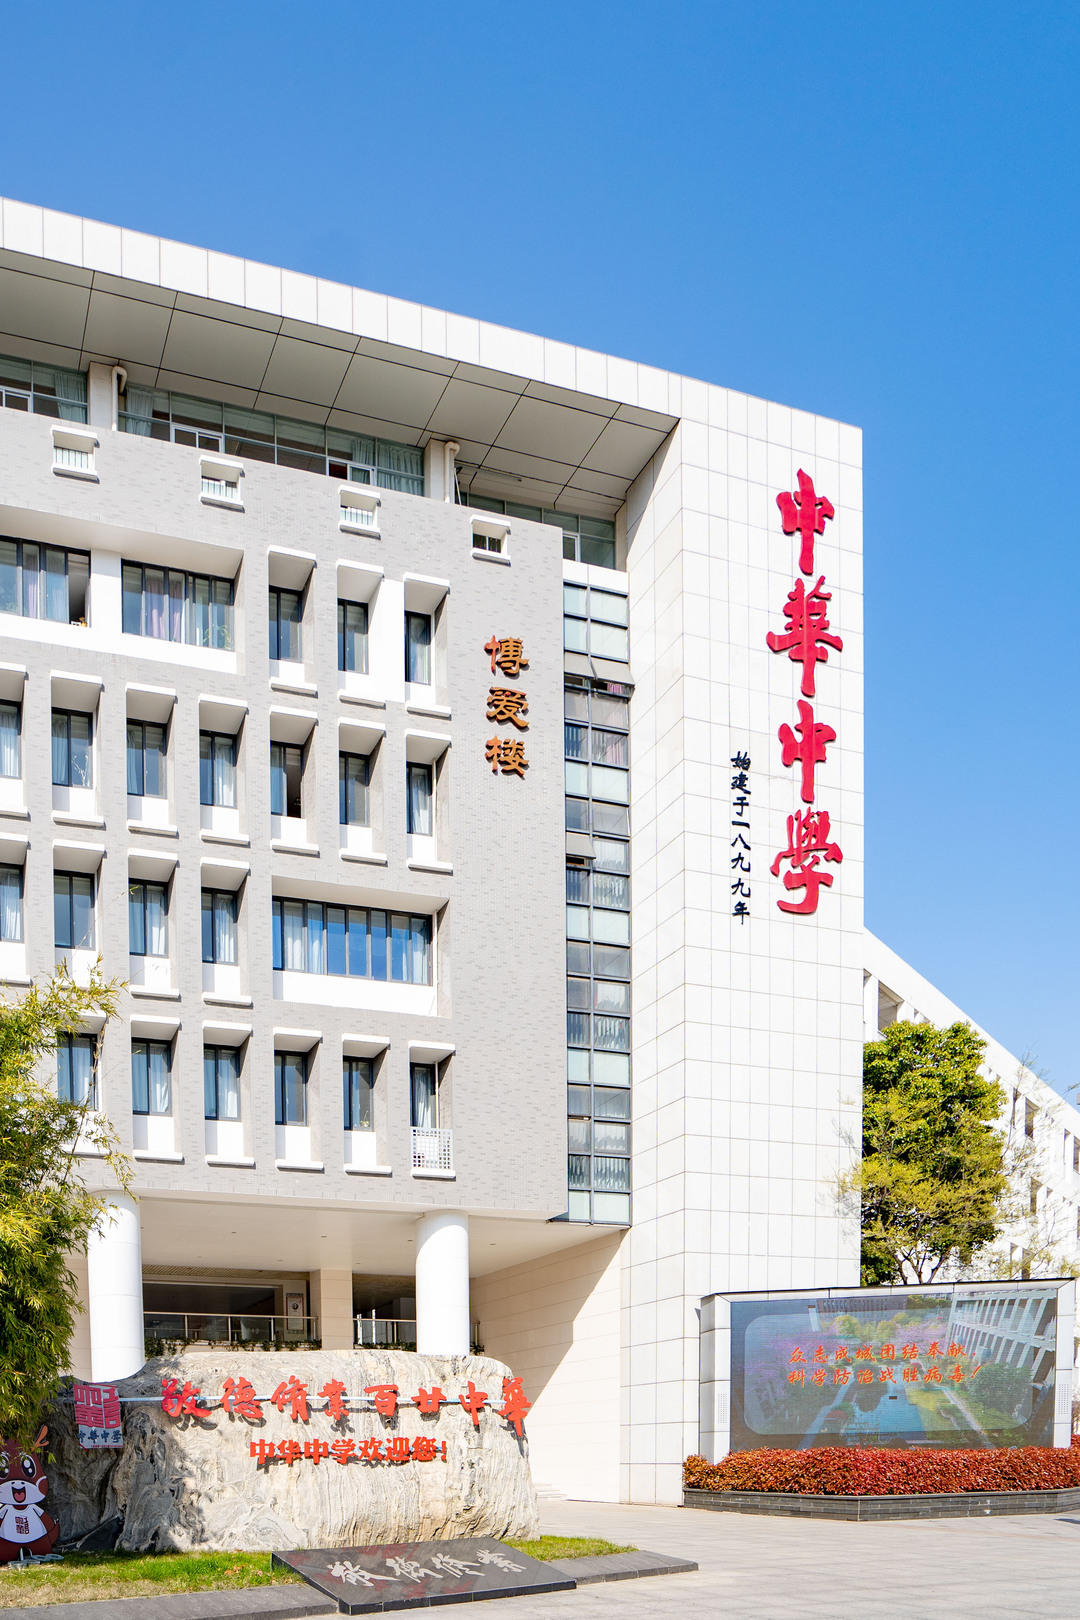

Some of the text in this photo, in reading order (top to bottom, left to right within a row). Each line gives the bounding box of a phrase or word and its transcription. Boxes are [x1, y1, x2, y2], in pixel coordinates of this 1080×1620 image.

[484, 635, 530, 777] 博爱楼
[730, 750, 752, 925] 始建于一八九九年
[249, 1436, 447, 1465] 中华中学欢迎您！
